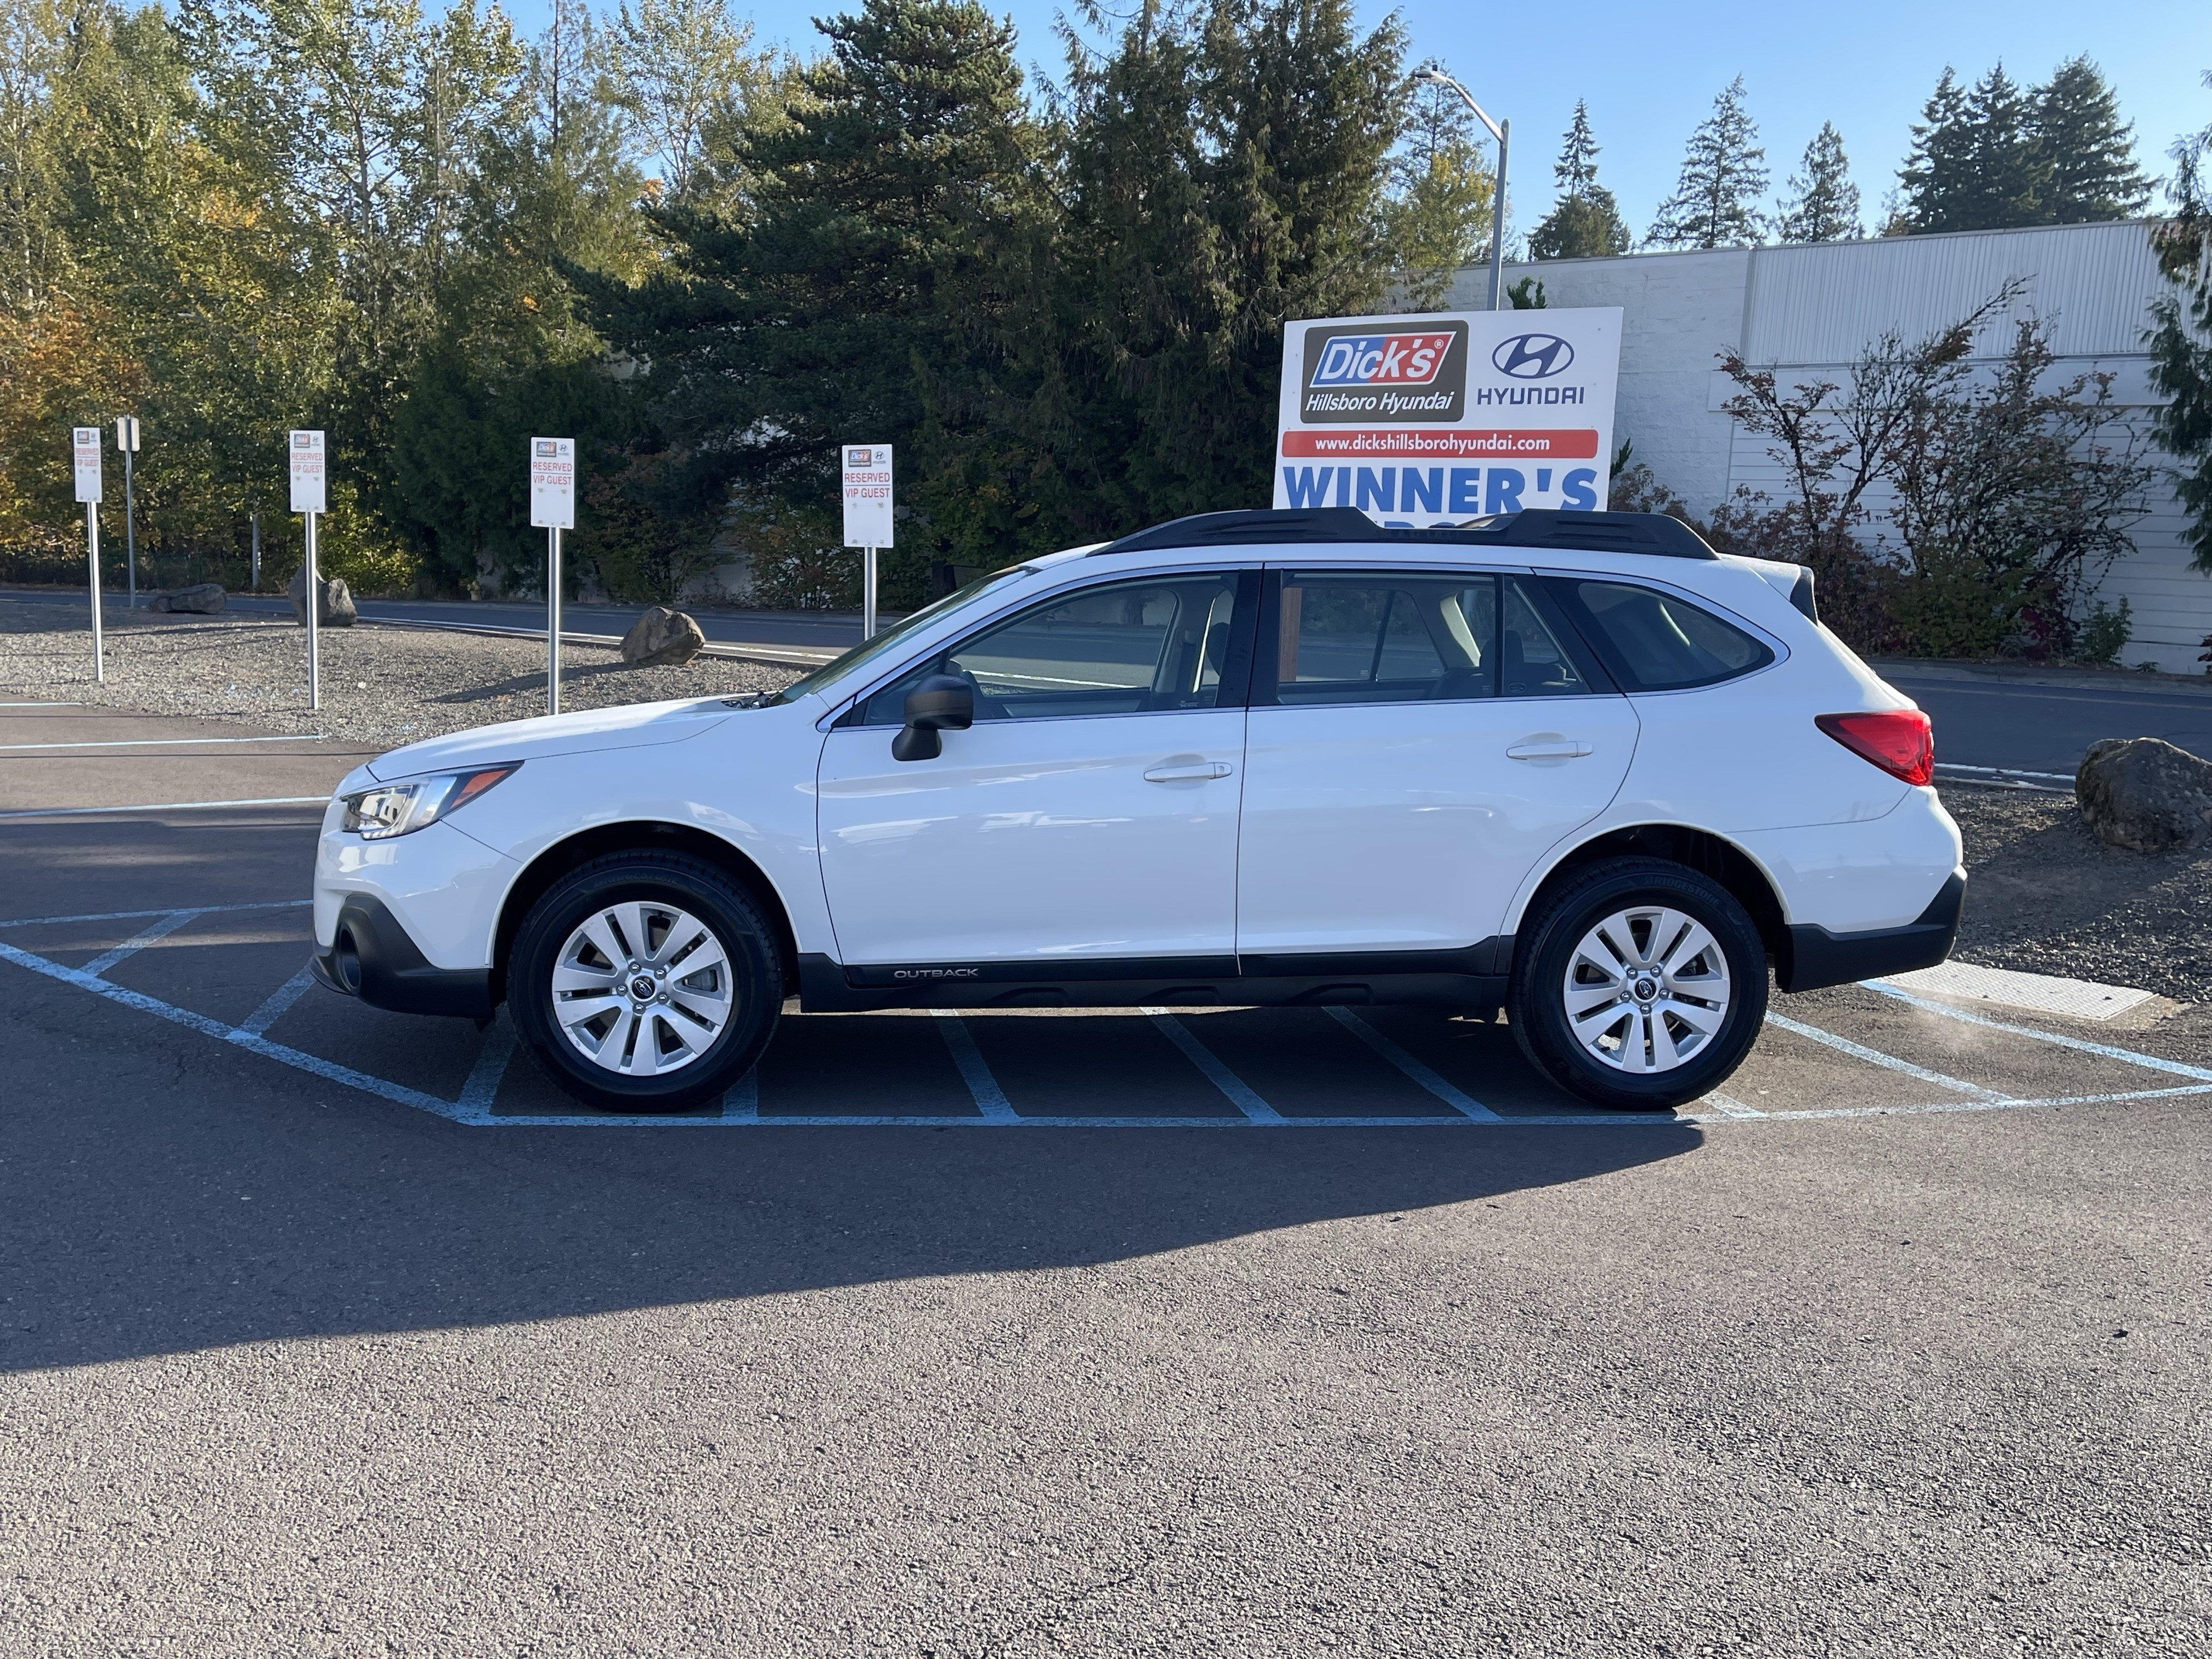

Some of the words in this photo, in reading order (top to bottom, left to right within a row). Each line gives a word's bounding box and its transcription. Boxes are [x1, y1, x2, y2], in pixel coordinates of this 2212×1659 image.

[1320, 338, 1436, 380] Dick's
[1477, 386, 1584, 405] HYUNDAI
[1306, 393, 1377, 411] Hillsboro
[1379, 391, 1455, 415] Hyundai
[1315, 433, 1550, 455] www.dickshillsborohyundai.com
[291, 452, 323, 461] RESERVED
[303, 465, 323, 473] GUEST
[533, 461, 572, 472] RESERVED
[533, 475, 544, 483] VIP
[547, 476, 572, 486] GUEST
[844, 472, 890, 483] RESERVED
[845, 488, 858, 498] VIP
[861, 488, 890, 498] GUEST
[1283, 466, 1598, 514] WINNER'S
[894, 968, 979, 978] OUTBACK
